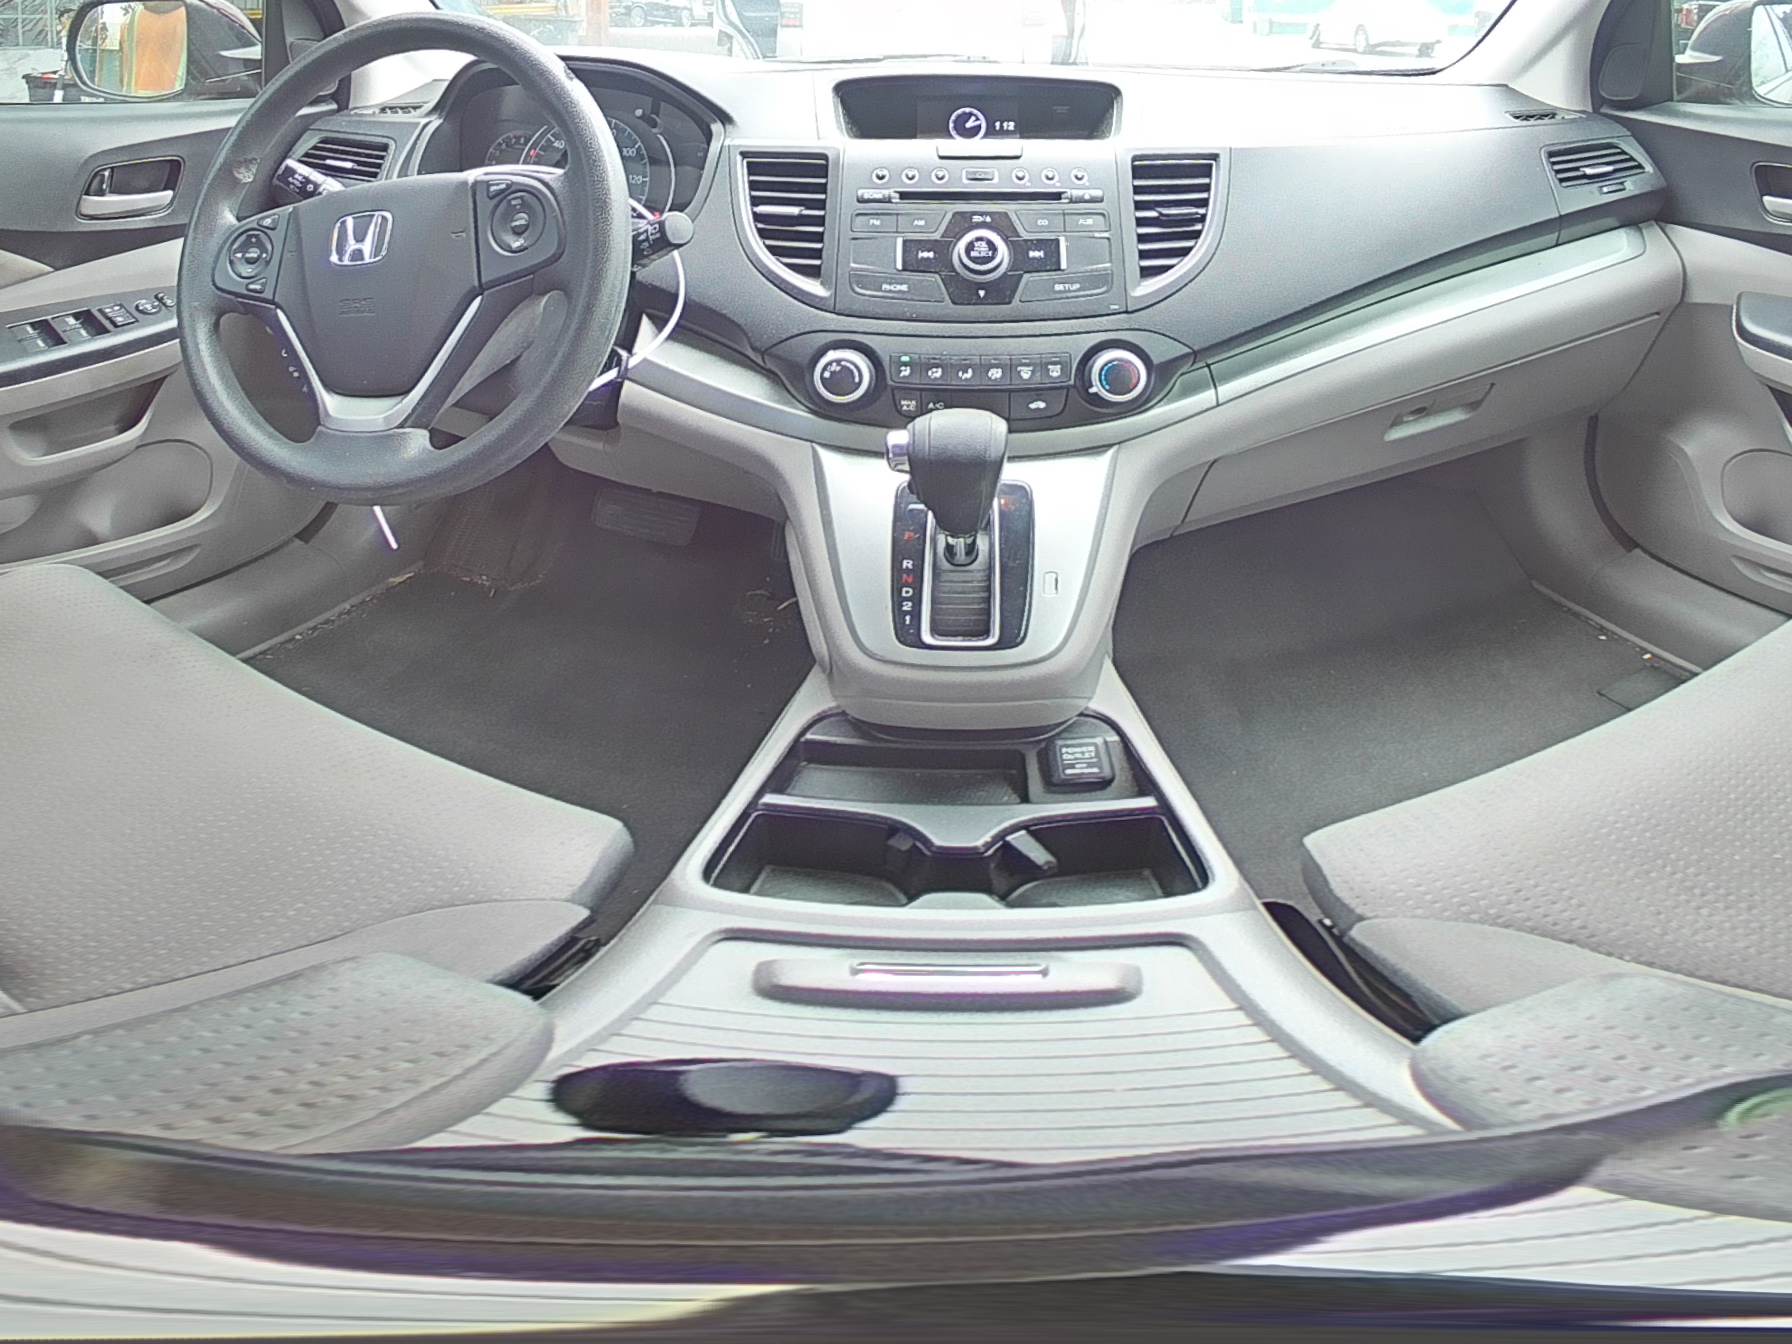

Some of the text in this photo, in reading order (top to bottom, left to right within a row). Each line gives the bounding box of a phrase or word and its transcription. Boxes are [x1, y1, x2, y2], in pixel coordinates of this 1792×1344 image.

[553, 140, 565, 149] 40
[622, 147, 637, 157] 100
[628, 174, 643, 184] 120
[882, 283, 909, 292] PHONE
[1054, 283, 1081, 291] SETUP
[903, 531, 915, 540] P
[902, 559, 913, 569] R
[902, 575, 914, 584] N
[902, 587, 913, 597] D
[901, 601, 913, 611] 2
[905, 615, 911, 625] 1
